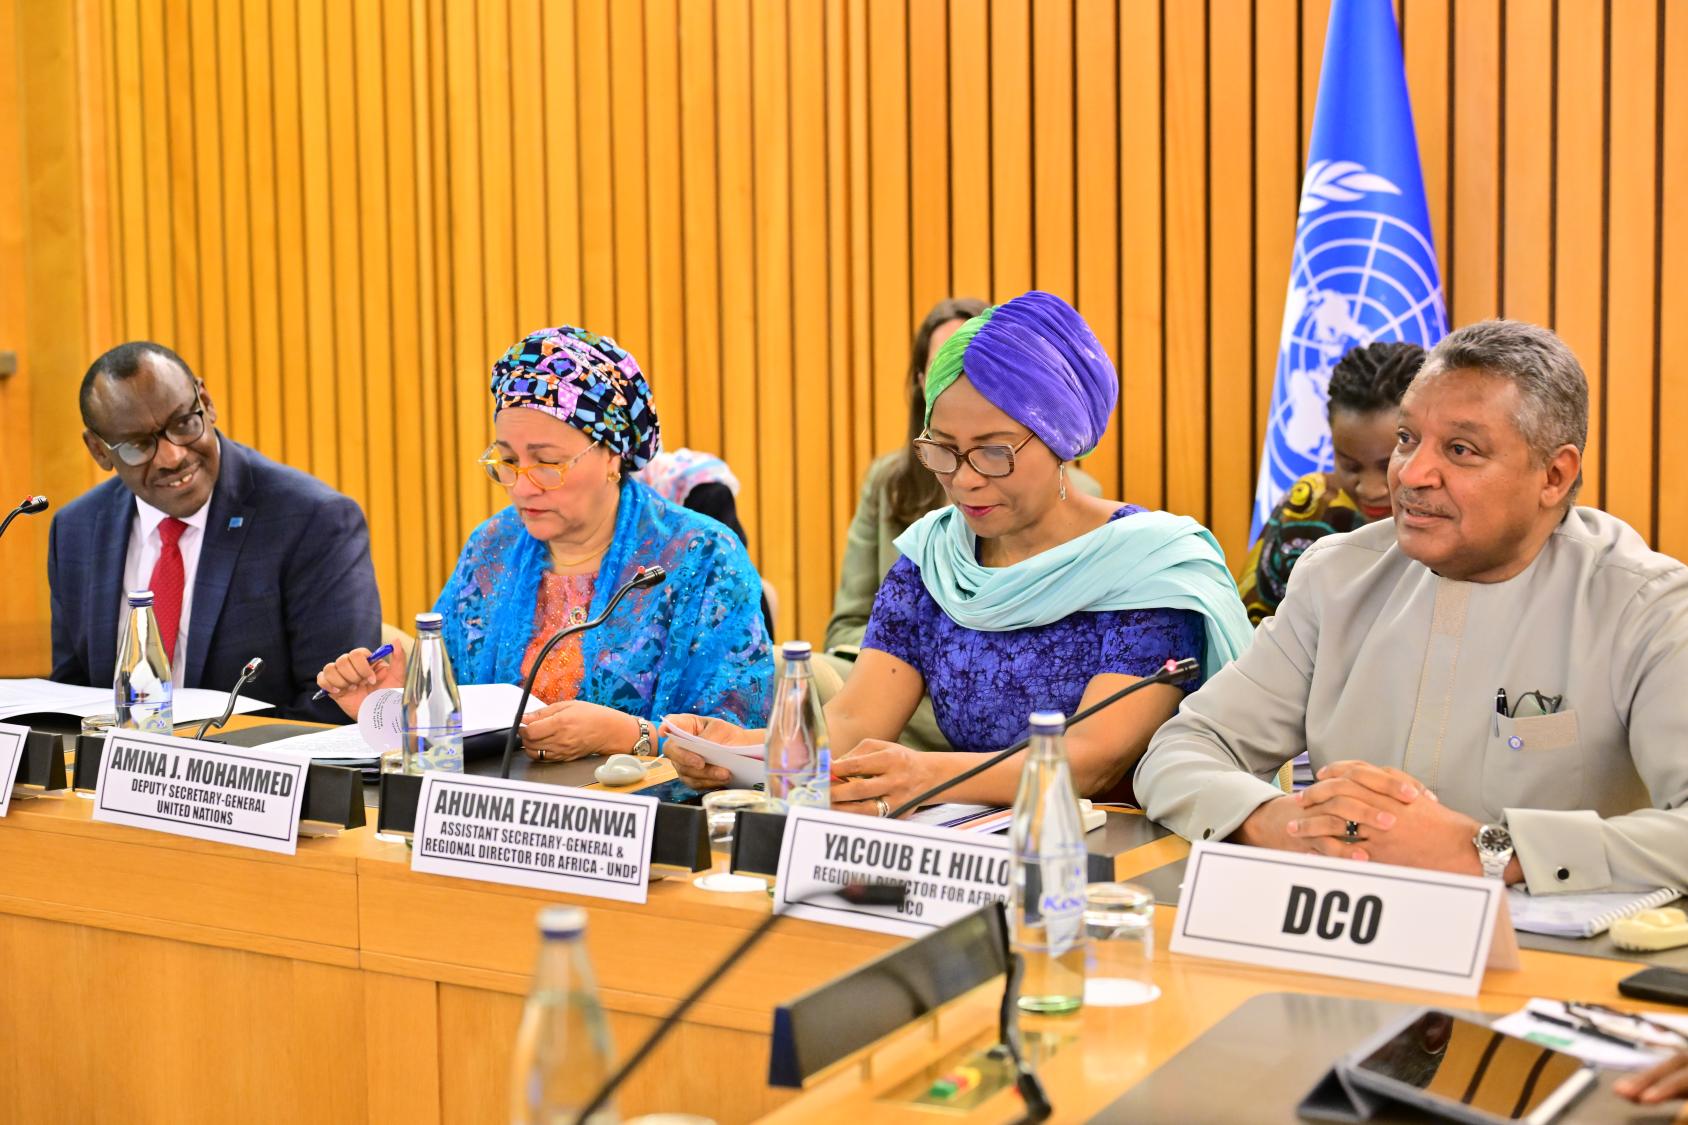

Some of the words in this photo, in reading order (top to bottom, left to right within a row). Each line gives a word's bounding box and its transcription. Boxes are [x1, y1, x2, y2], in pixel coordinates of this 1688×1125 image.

[111, 746, 167, 778] AMINA
[170, 755, 181, 780] J.
[185, 758, 293, 797] MOHAMMED
[131, 778, 168, 796] DEPUTY
[168, 784, 266, 813] SECRETARY-GENERAL
[157, 800, 190, 818] UNITED
[192, 806, 233, 825] NATIONS
[434, 789, 514, 823] AHUNNA
[519, 799, 637, 839] EZIAKONWA
[425, 837, 476, 858] REGIONAL
[478, 844, 532, 865] DIRECTOR
[534, 852, 555, 868] FOR
[557, 855, 597, 874] AFRICA
[607, 862, 638, 879] UNDP
[440, 821, 501, 841] ASSISTANT
[501, 829, 613, 857] SECRETARY-GENERAL
[616, 846, 624, 858] &
[824, 832, 914, 872] YACOUB
[919, 848, 941, 876] EL
[941, 885, 964, 902] FOR
[1282, 885, 1383, 945] DCO
